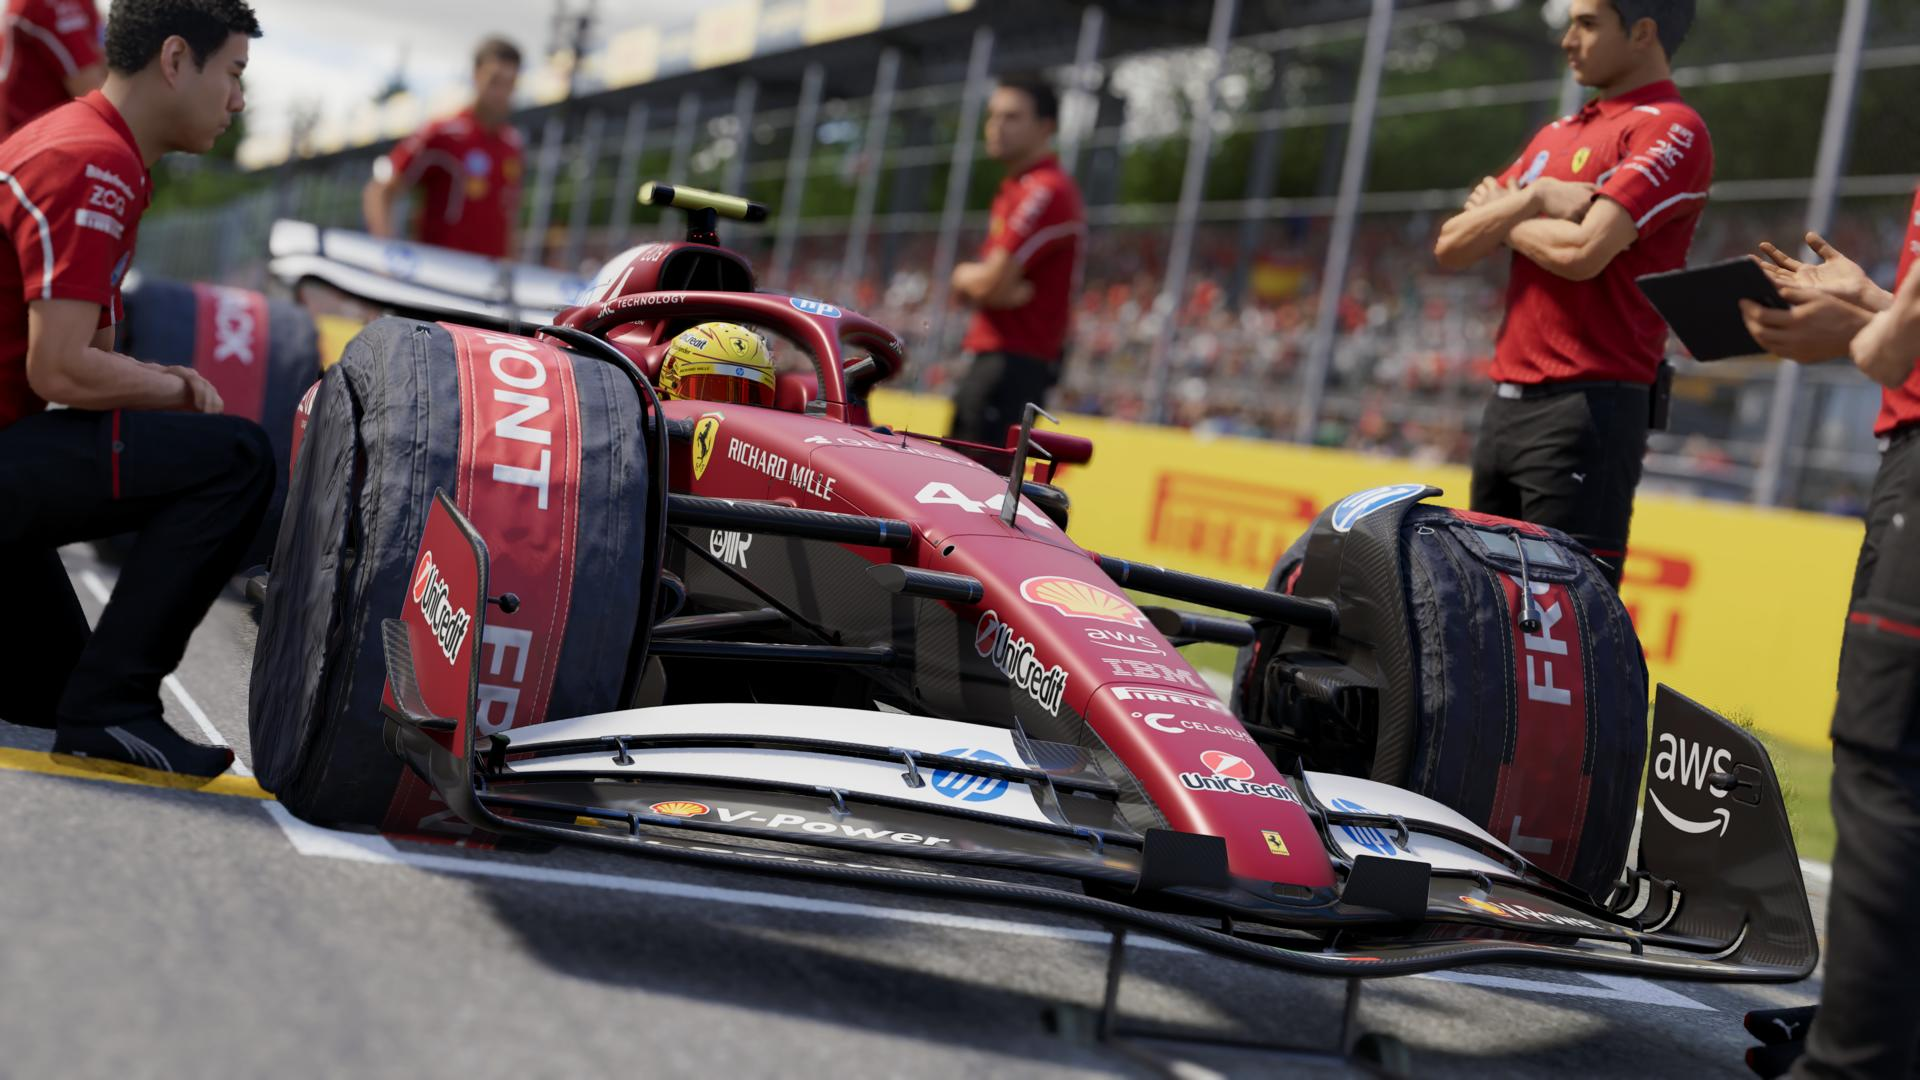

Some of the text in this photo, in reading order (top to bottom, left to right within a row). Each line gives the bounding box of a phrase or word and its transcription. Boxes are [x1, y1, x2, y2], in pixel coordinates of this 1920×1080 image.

[617, 295, 687, 308] TECHNOLOGY
[727, 437, 837, 501] RICHARD MILLE
[914, 482, 1054, 529] 44
[421, 564, 470, 665] UniCredit
[1084, 628, 1158, 649] aws
[993, 624, 1068, 716] UniCredit
[1101, 657, 1204, 689] IBM
[1180, 720, 1254, 742] CELSIUS
[1655, 732, 1732, 799] aws
[1180, 773, 1300, 805] UniCredit
[716, 807, 951, 846] V-Power
